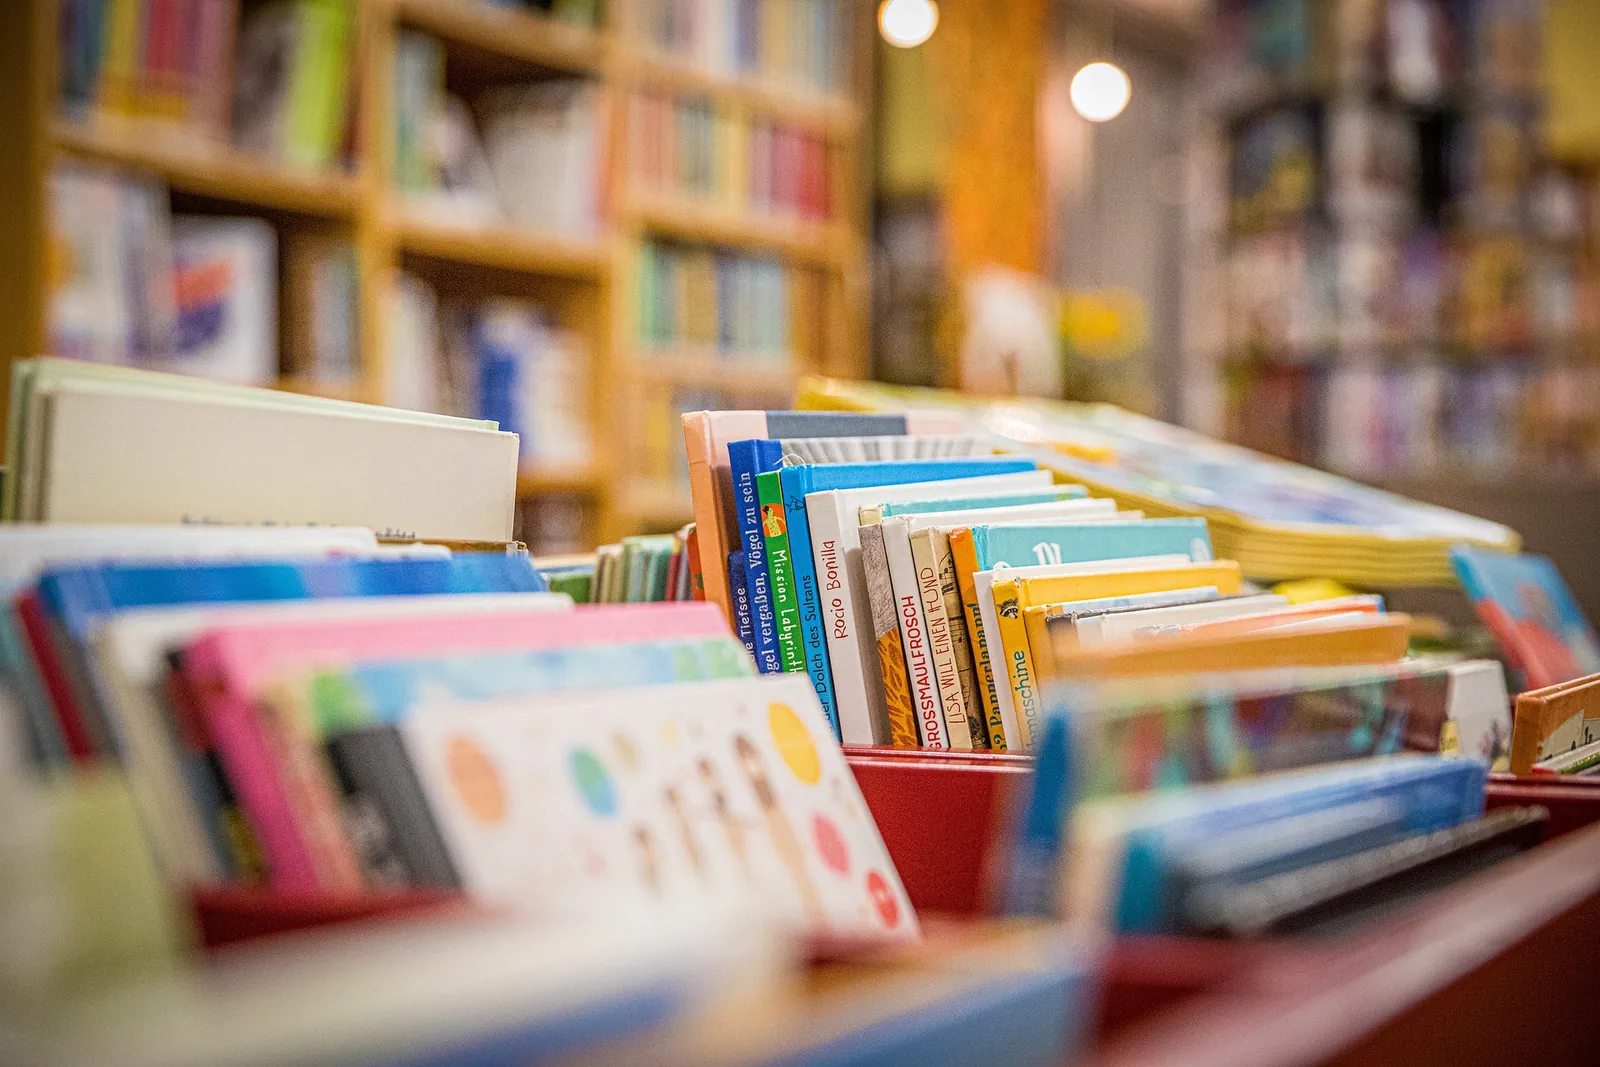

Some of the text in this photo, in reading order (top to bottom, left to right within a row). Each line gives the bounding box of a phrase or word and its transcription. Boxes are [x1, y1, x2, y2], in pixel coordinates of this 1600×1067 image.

[738, 472, 754, 503] sein
[745, 507, 757, 525] zu
[745, 529, 764, 569] Vögel
[737, 587, 752, 637] Tiefsee
[755, 572, 773, 645] vergaßen,
[772, 549, 803, 675] Mission Labyrinth
[802, 574, 817, 622] Sultans
[820, 540, 849, 640] Rocio Bonilla
[808, 625, 820, 649] des
[920, 567, 966, 724] LISA WILL EINEN HUND
[811, 653, 827, 694] Dolch
